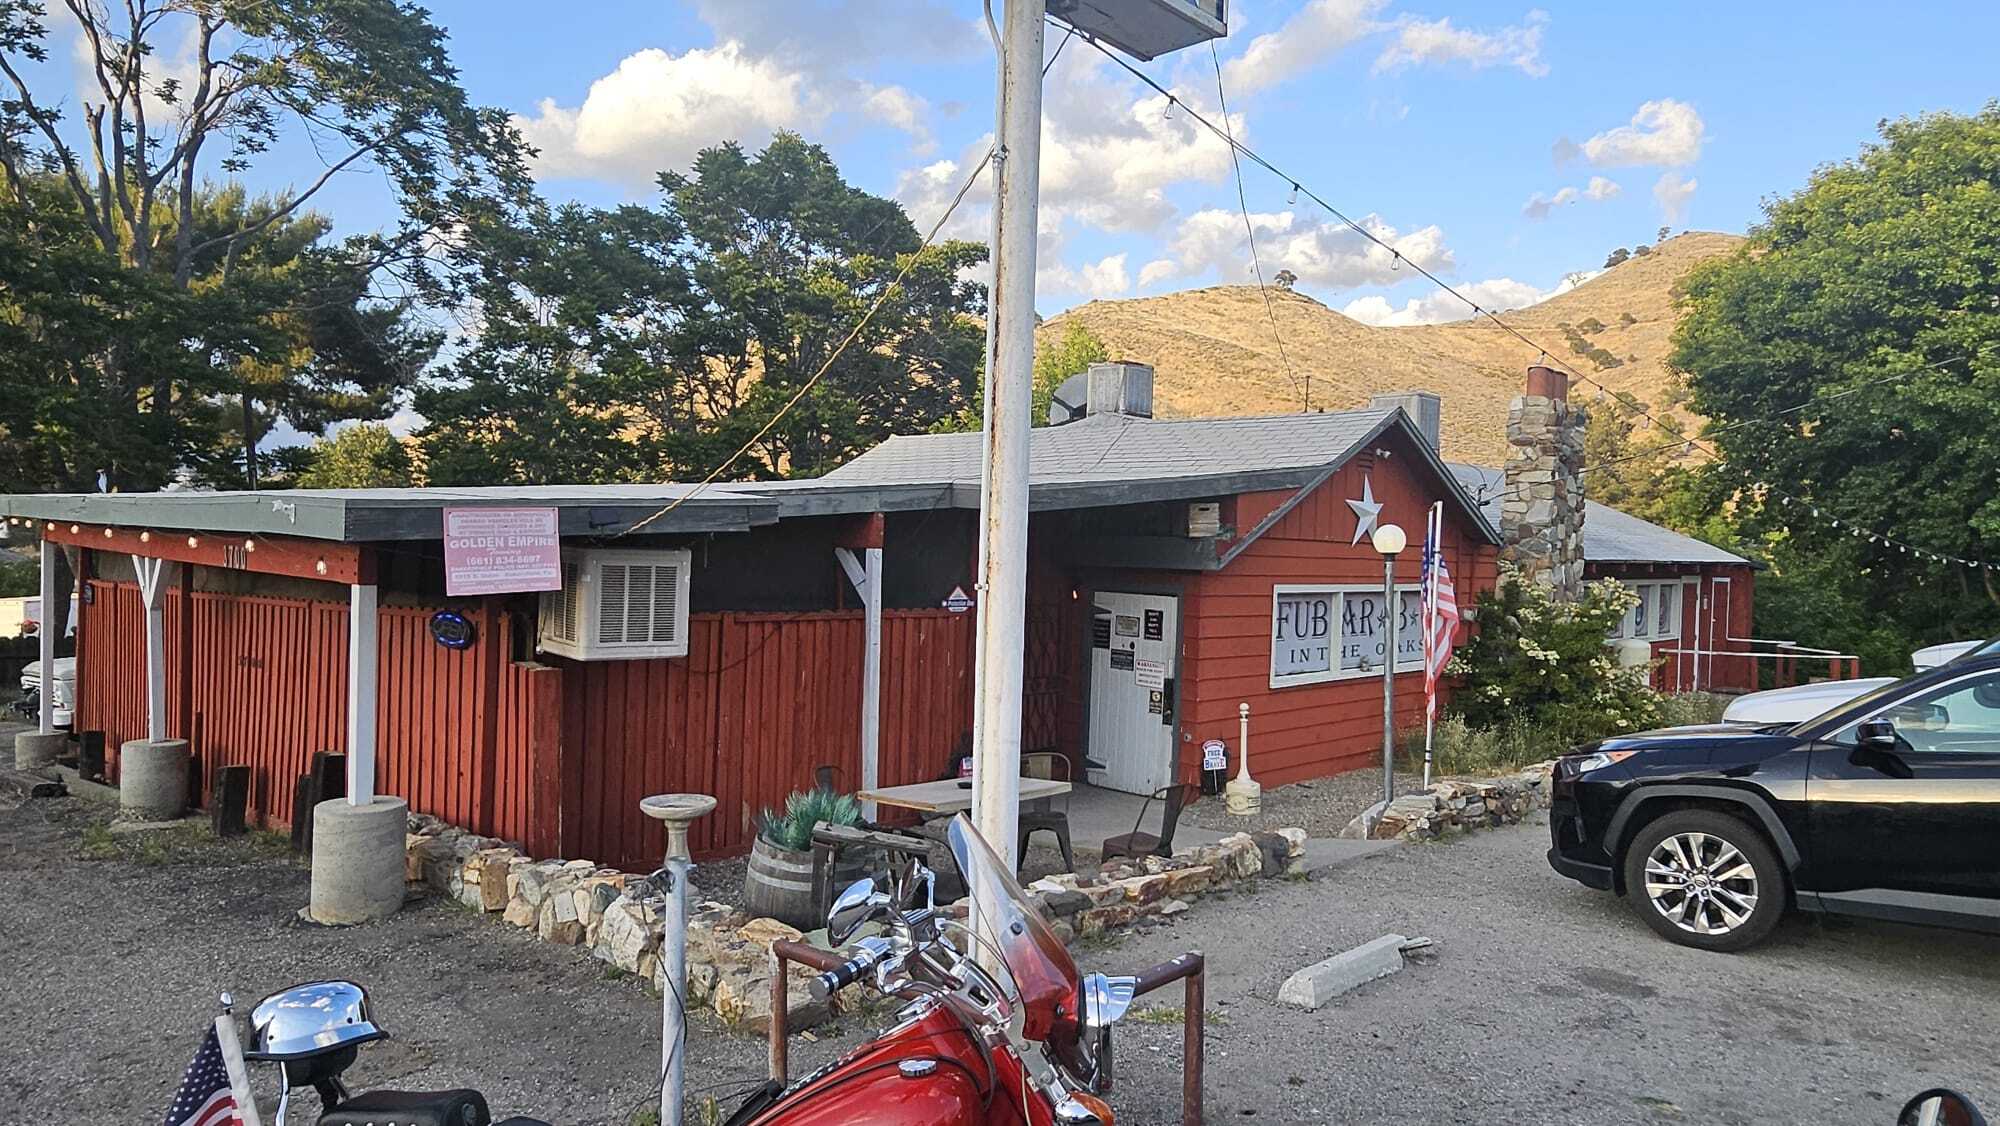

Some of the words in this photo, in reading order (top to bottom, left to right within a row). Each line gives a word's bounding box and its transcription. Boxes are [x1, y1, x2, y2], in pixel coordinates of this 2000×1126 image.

[449, 537, 507, 549] GOLDEN
[508, 536, 555, 547] EMPIRE
[223, 545, 246, 570] 3700
[466, 556, 493, 567] (661)
[1290, 648, 1311, 663] IN
